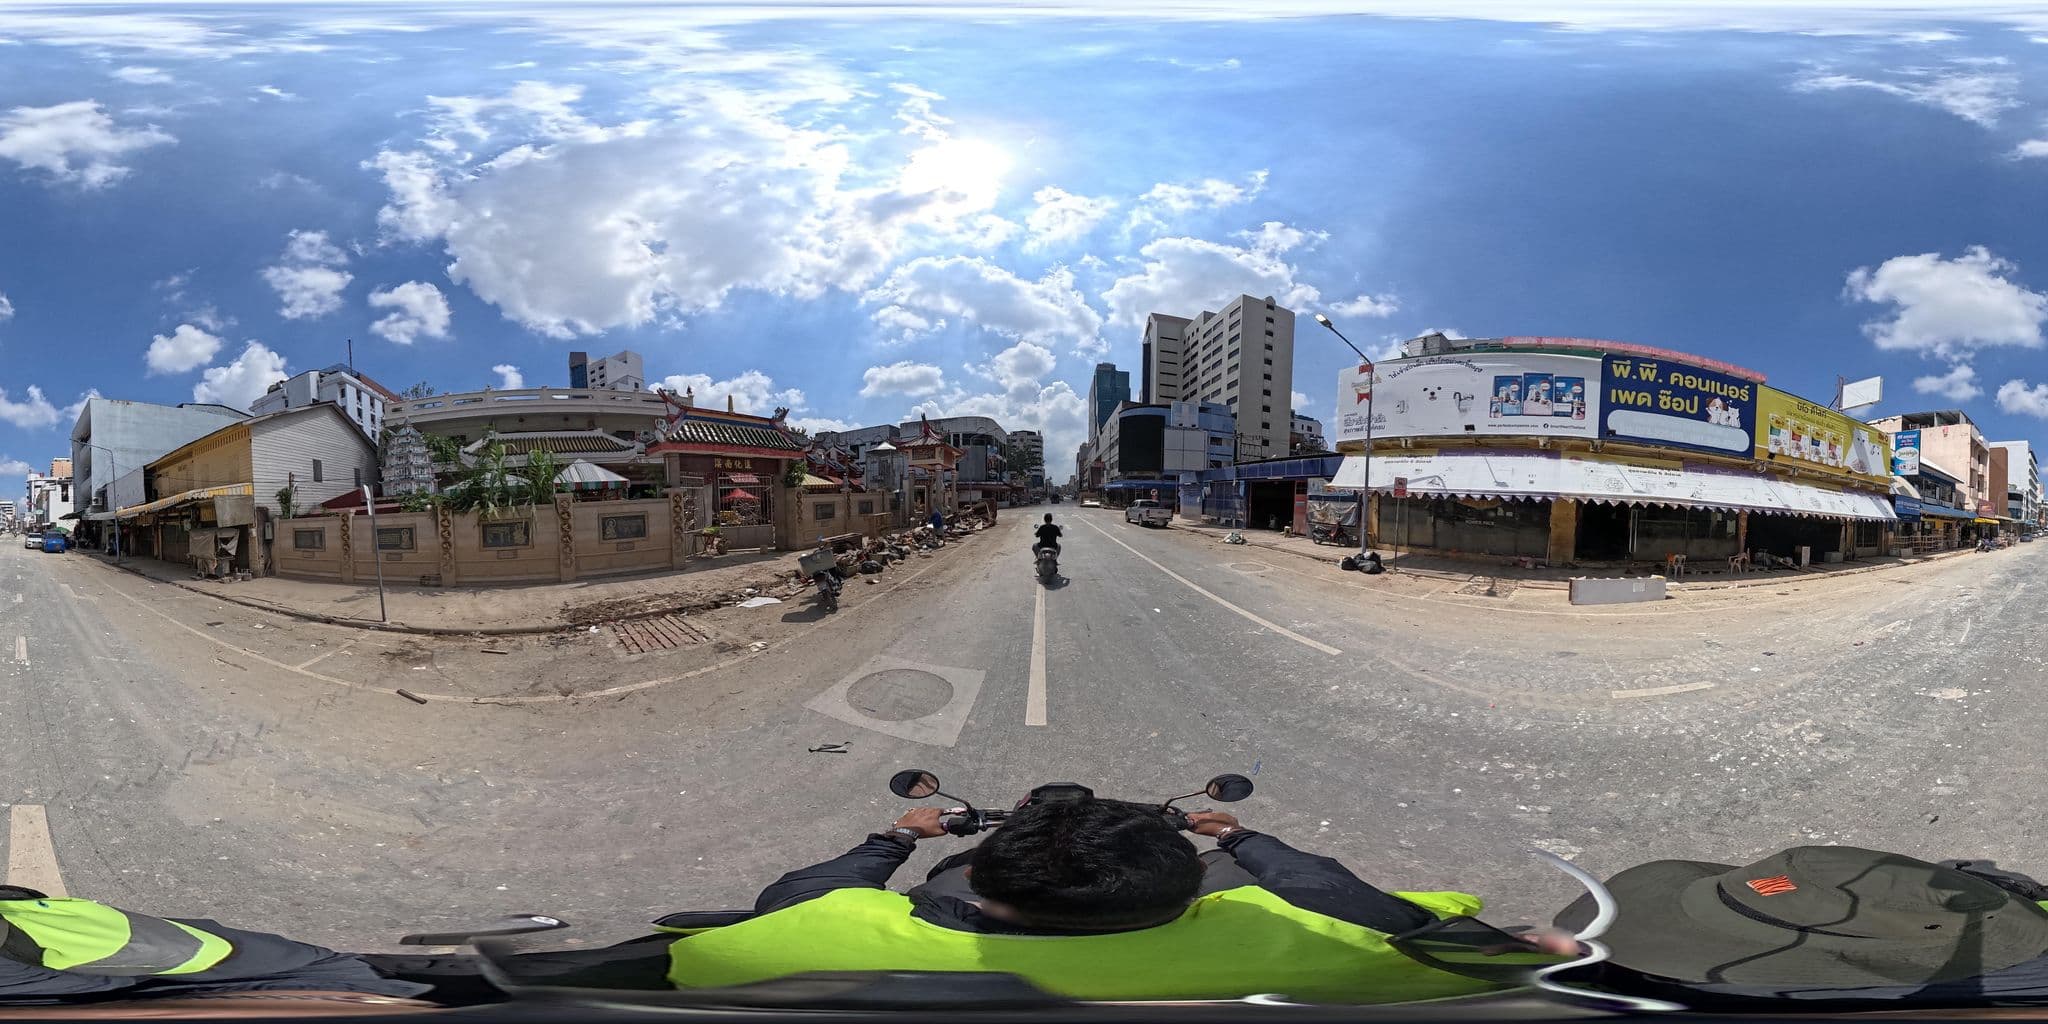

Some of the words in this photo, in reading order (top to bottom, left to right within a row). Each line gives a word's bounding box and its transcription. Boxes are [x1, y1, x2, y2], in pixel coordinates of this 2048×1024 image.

[1611, 389, 1652, 408] เพด
[1670, 372, 1750, 402] คอนเนอร์
